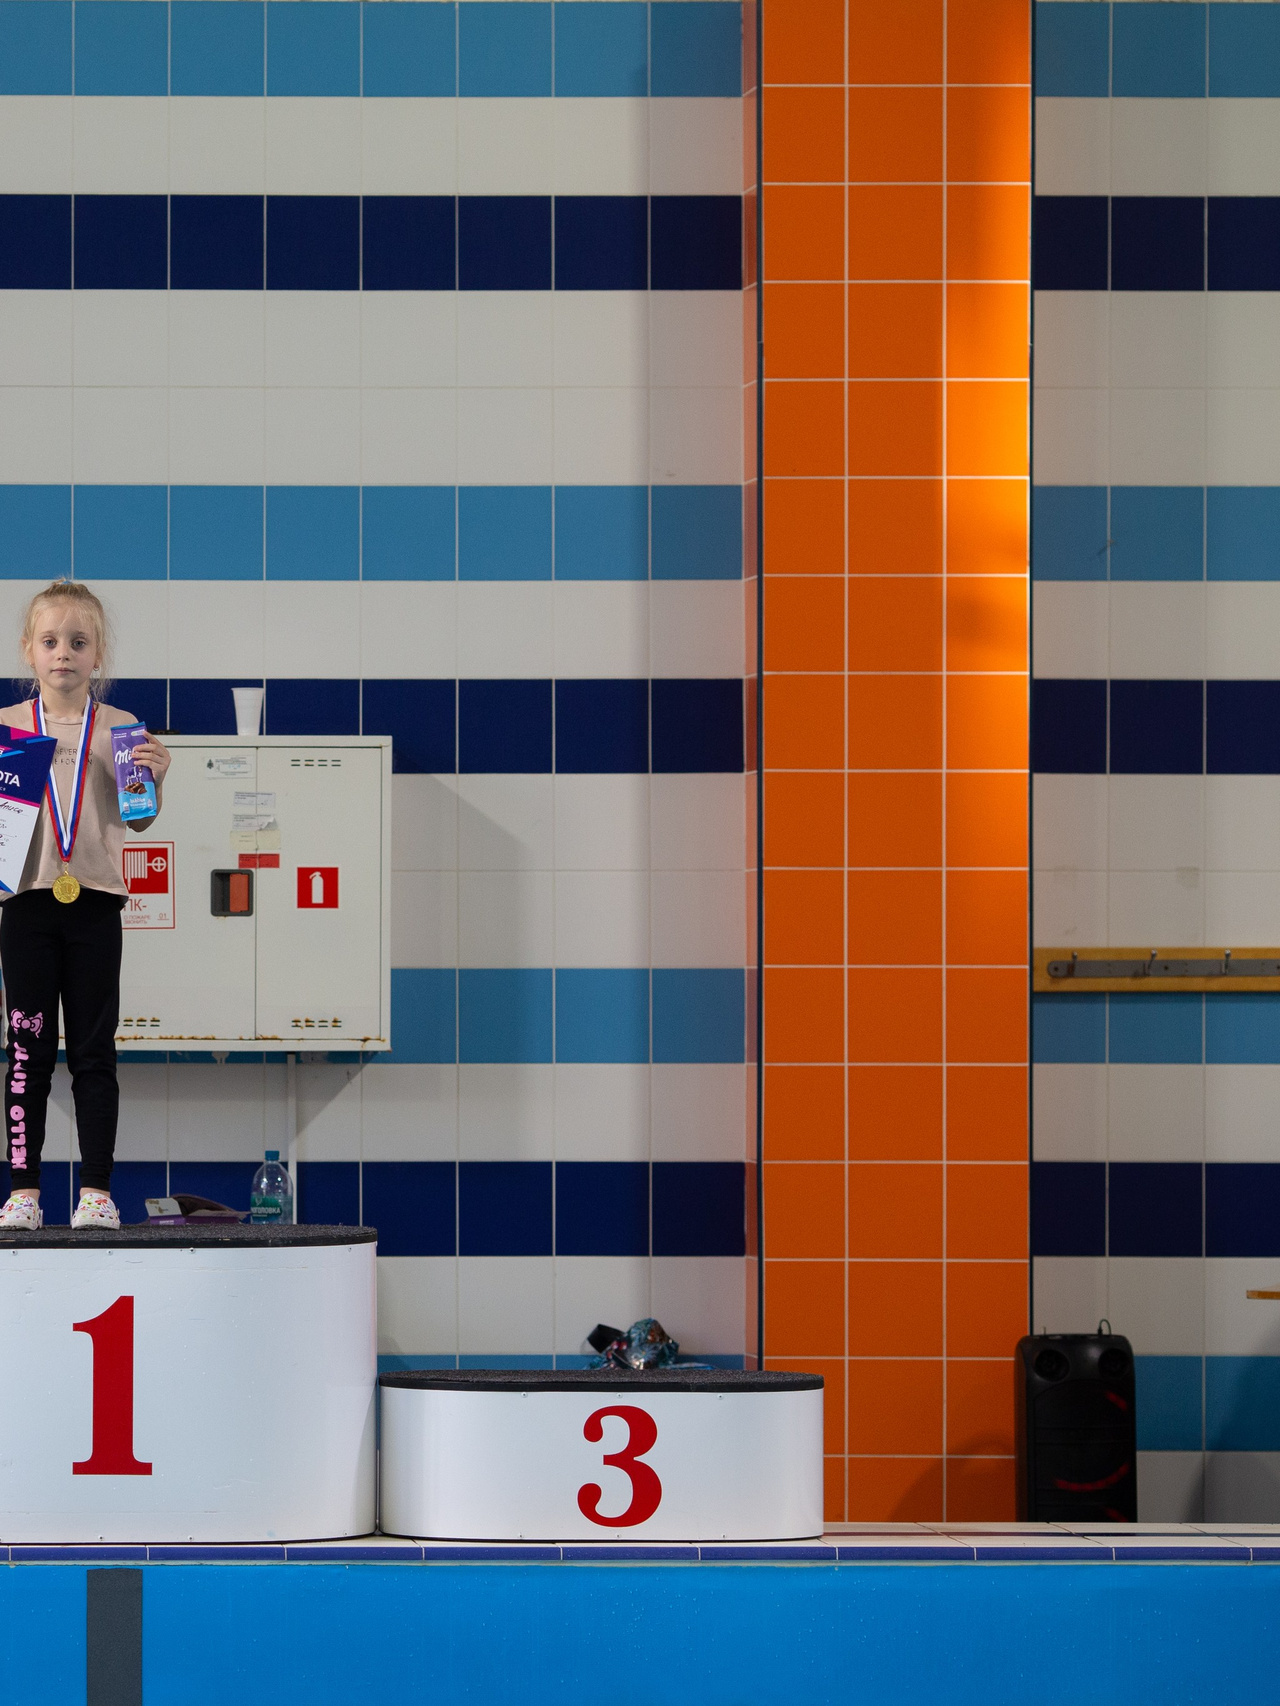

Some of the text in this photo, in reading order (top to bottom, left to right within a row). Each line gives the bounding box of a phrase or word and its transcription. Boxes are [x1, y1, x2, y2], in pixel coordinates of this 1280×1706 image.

[10, 1104, 28, 1170] HELLO
[72, 1295, 153, 1476] 1
[577, 1405, 662, 1528] 3
